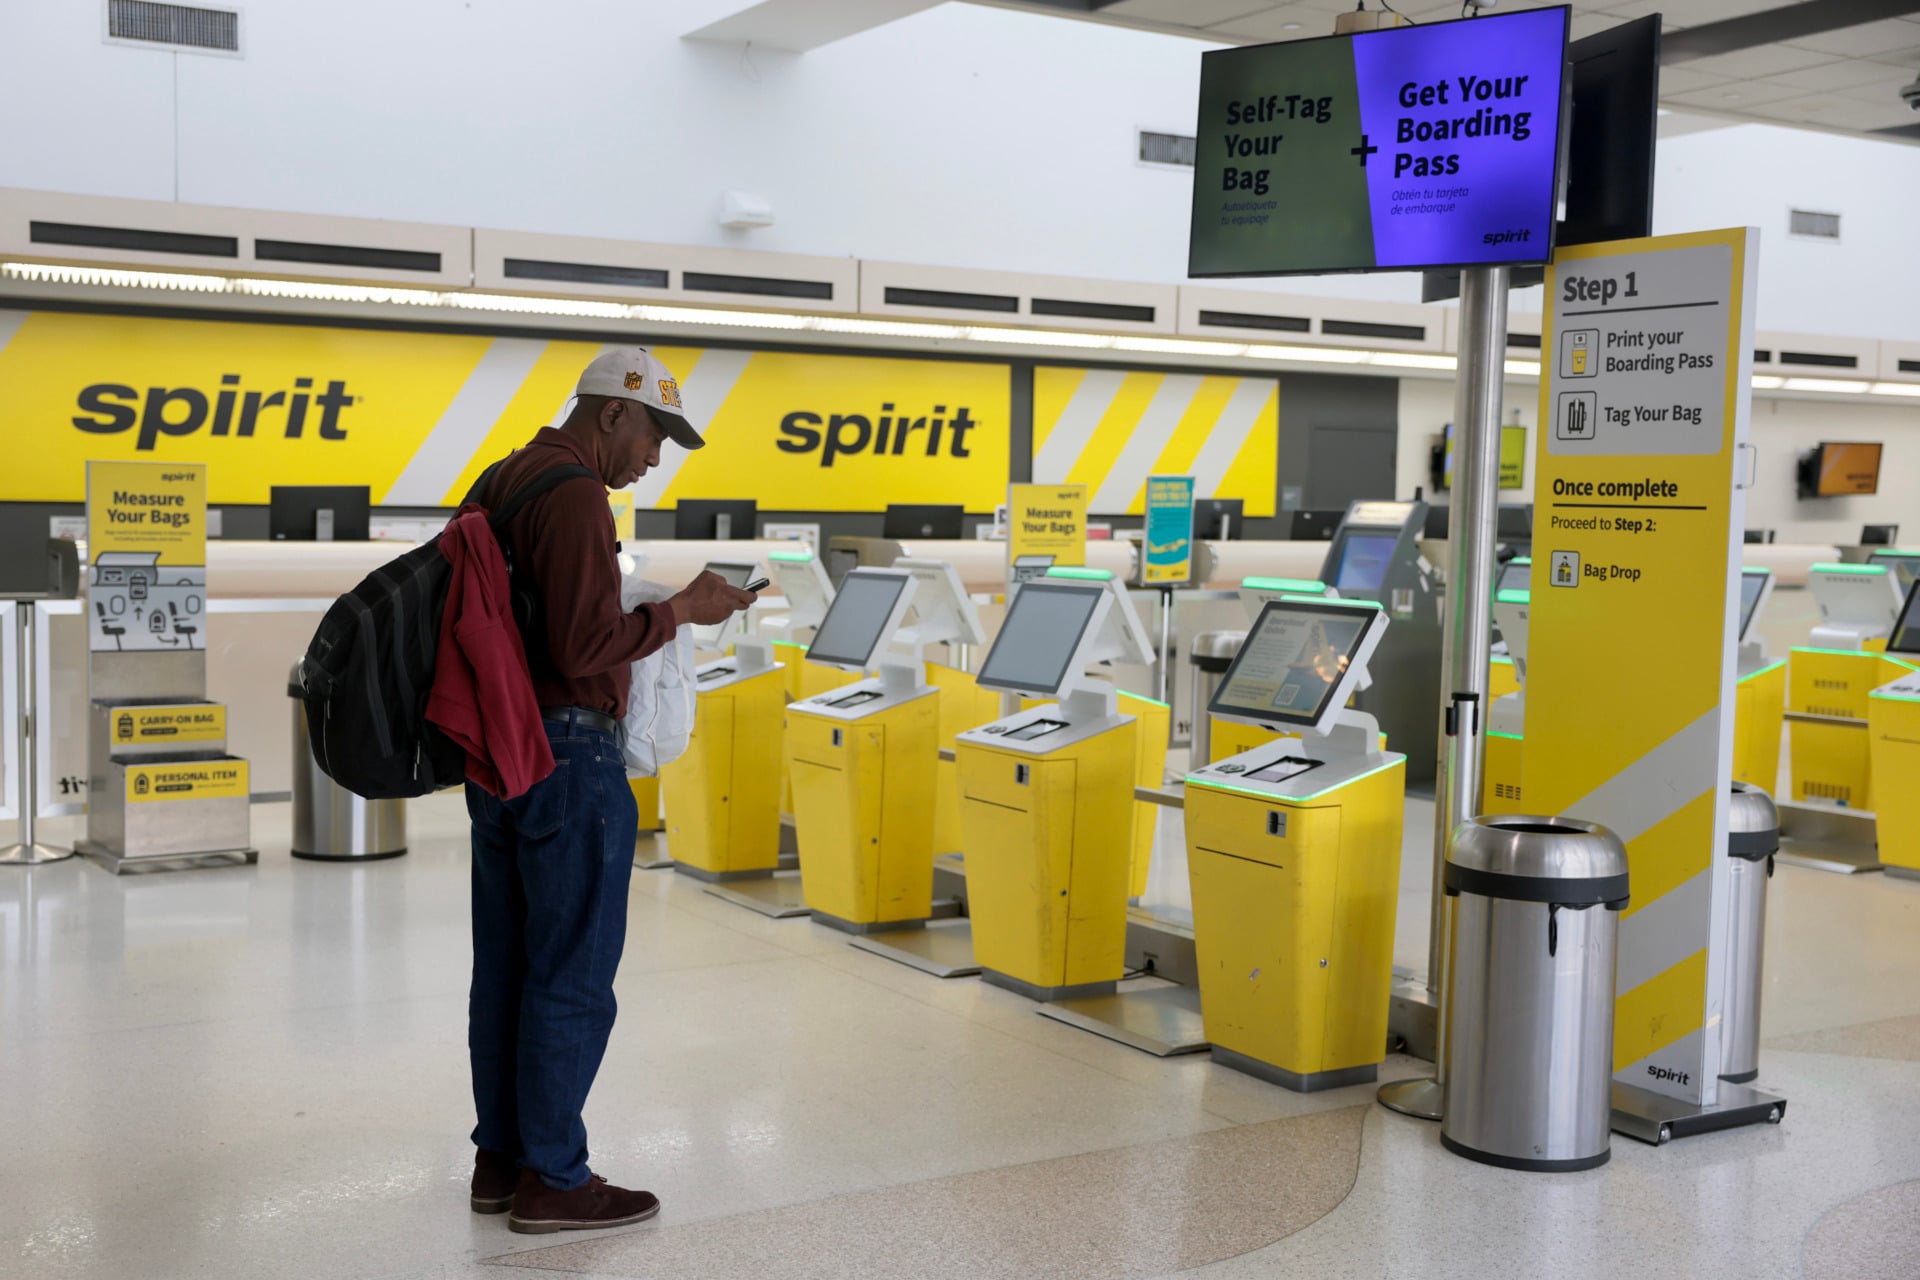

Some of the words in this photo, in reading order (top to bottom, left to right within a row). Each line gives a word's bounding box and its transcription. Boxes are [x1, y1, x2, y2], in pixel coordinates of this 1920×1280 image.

[1399, 81, 1449, 108] Get
[1458, 75, 1528, 102] Your
[1227, 96, 1332, 125] Self-Tag
[1396, 108, 1531, 143] Boarding
[1224, 134, 1283, 158] Your
[1394, 153, 1460, 178] Pass
[1222, 167, 1270, 195] Bag
[1392, 188, 1420, 201] Obtén
[1423, 189, 1433, 199] tu
[1436, 186, 1468, 200] tarjeta
[1391, 204, 1402, 215] de
[1404, 202, 1455, 215] embarque
[1221, 214, 1229, 224] tu
[1483, 229, 1530, 246] spirit
[1563, 276, 1617, 305] Step
[1624, 272, 1638, 297] 1
[1607, 330, 1644, 348] Print
[1648, 331, 1683, 349] your
[1606, 355, 1675, 374] Boarding
[1678, 353, 1713, 369] Pass
[72, 373, 353, 451] spirit
[1605, 407, 1630, 426] Tag
[1634, 407, 1669, 422] Your
[1672, 405, 1702, 424] Bag
[776, 404, 975, 467] spirit
[113, 492, 184, 506] Measure
[1553, 479, 1593, 496] Once
[1597, 479, 1678, 500] complete
[107, 509, 146, 523] Your
[151, 510, 190, 527] Bags
[1026, 508, 1072, 519] Measure
[1022, 522, 1047, 533] Your
[1050, 522, 1076, 535] Bags
[1552, 516, 1596, 529] Proceed
[1600, 518, 1611, 529] to
[1615, 518, 1642, 533] Step
[1645, 520, 1656, 532] 2:
[1584, 564, 1607, 581] Bag
[1611, 565, 1641, 581] Drop
[140, 715, 192, 725] CARRY-ON
[194, 715, 215, 723] BAG
[155, 772, 210, 783] PERSONAL
[212, 770, 237, 779] ITEM
[1648, 1065, 1691, 1085] spirit
